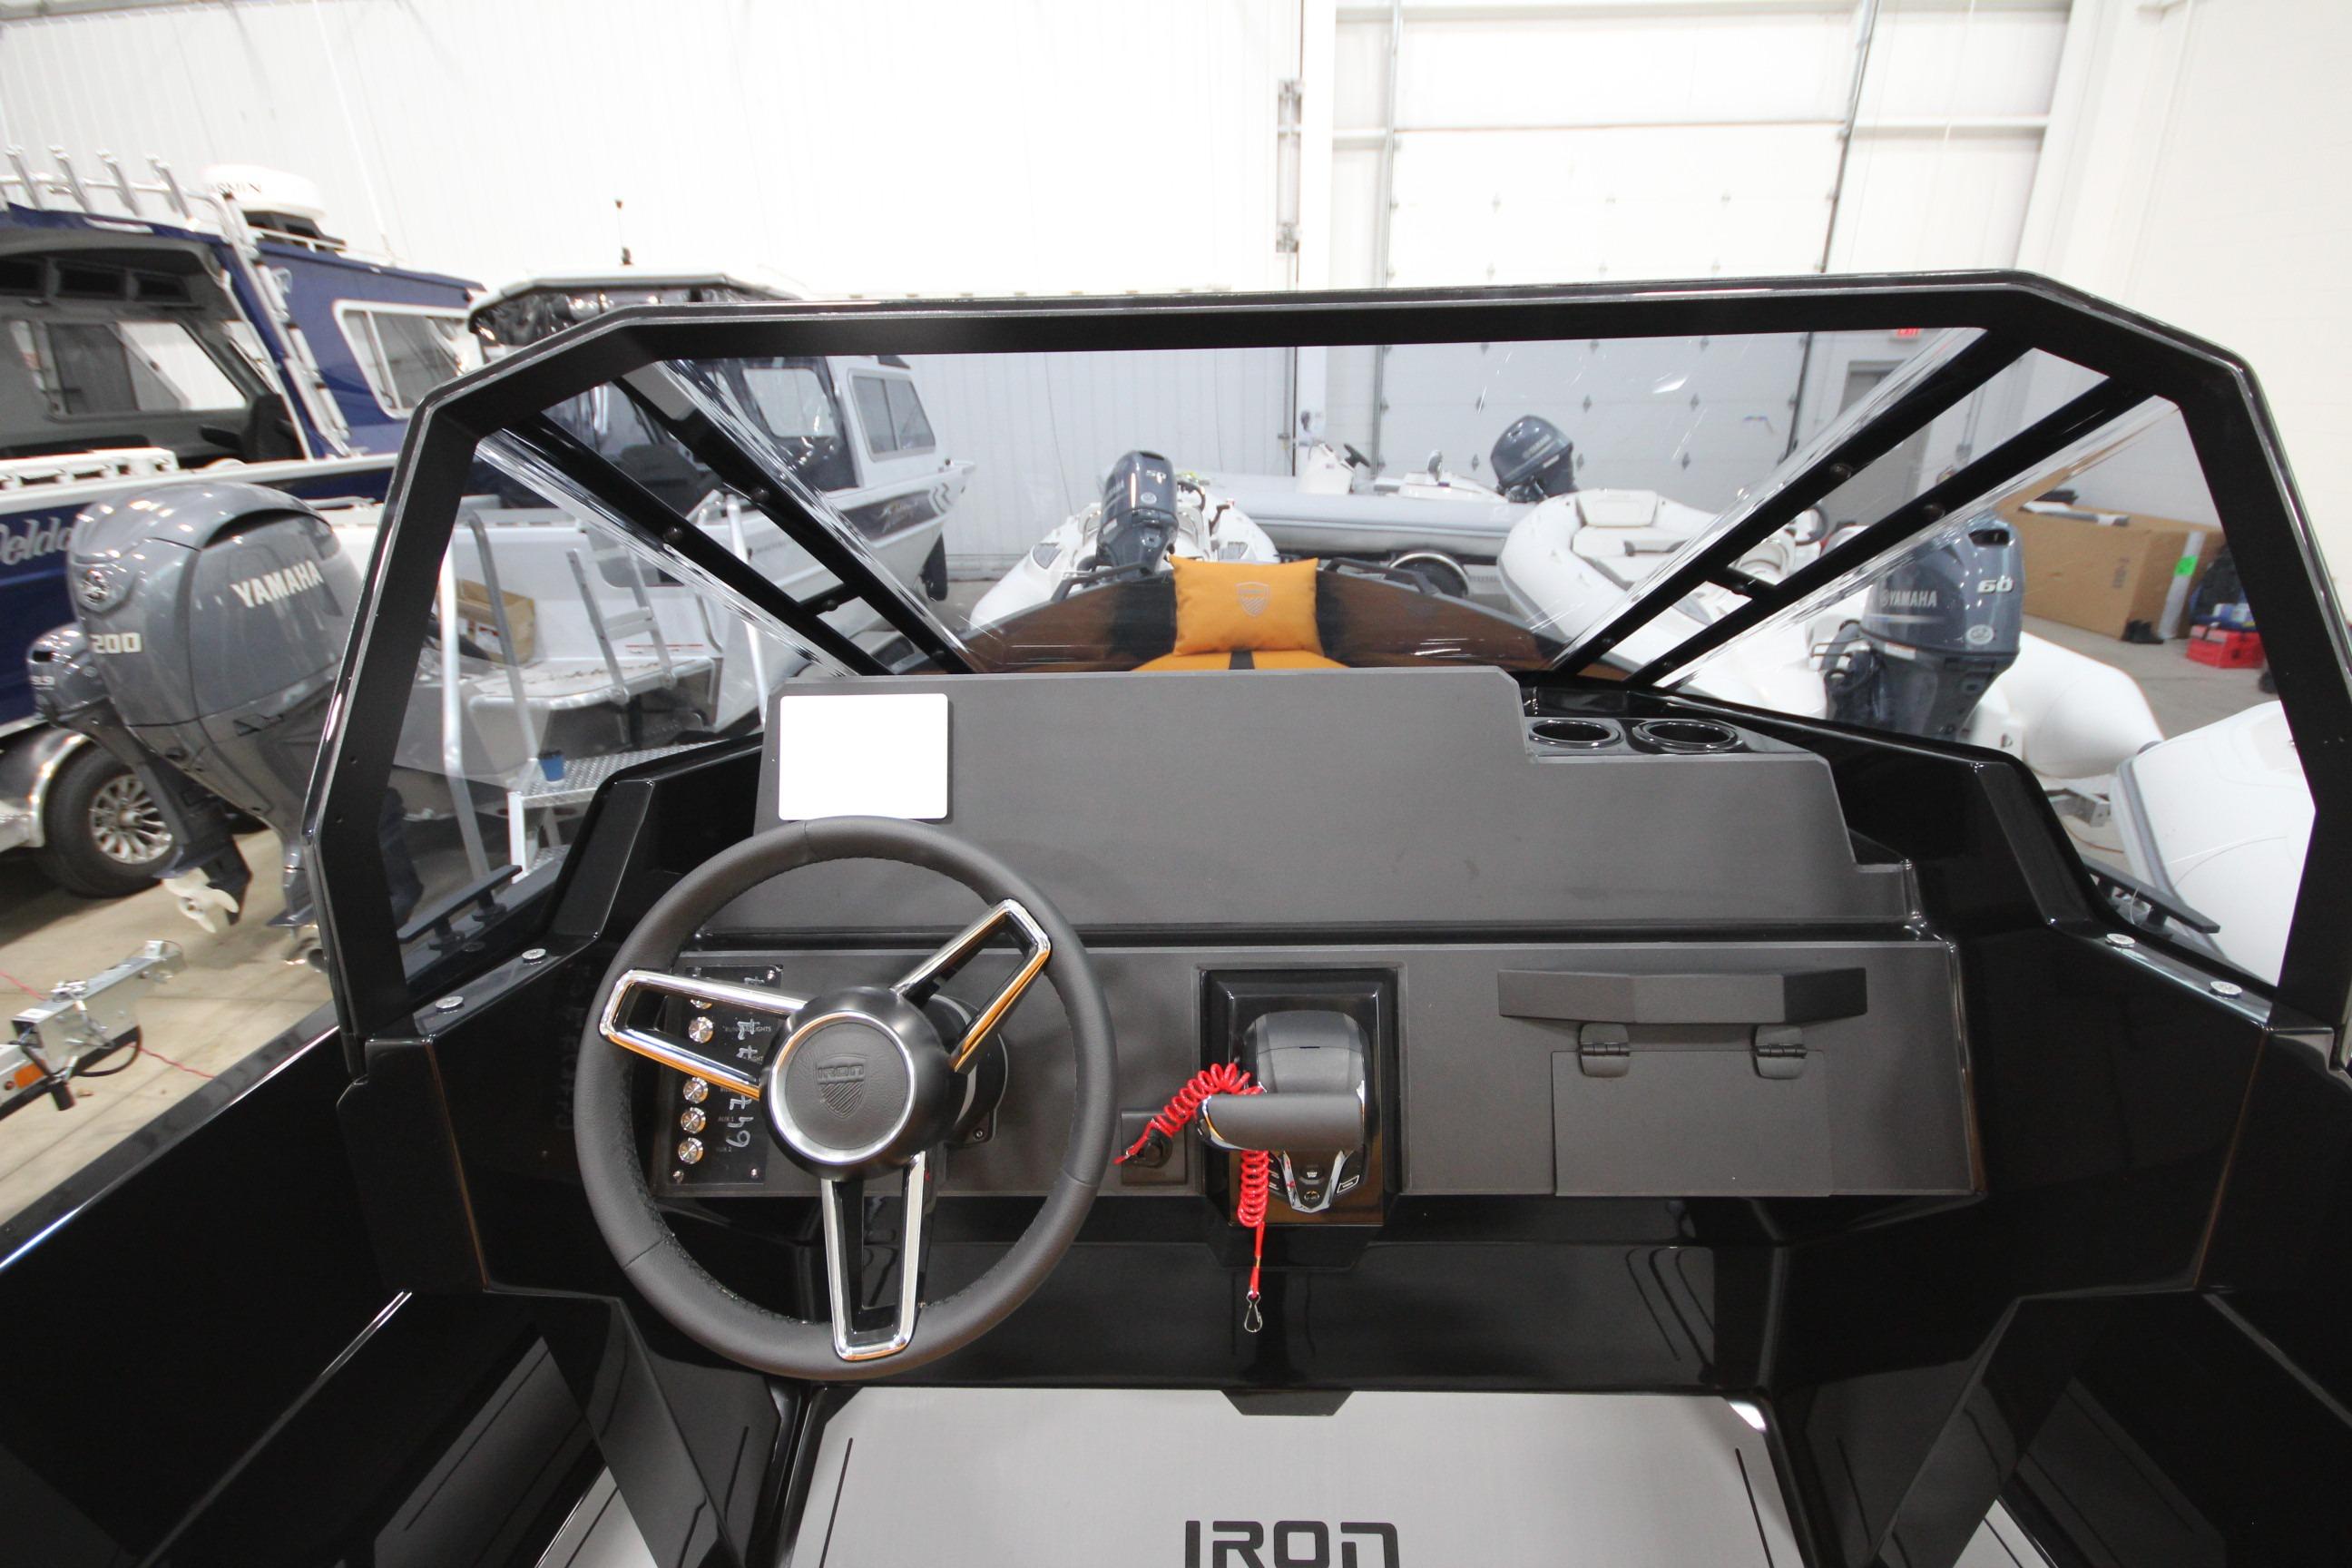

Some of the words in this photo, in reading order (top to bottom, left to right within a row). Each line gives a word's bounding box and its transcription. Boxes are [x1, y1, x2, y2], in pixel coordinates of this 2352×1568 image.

[229, 559, 325, 609] YAMAHA
[1888, 590, 1938, 609] YAMAHA
[89, 632, 142, 654] 200
[1184, 1520, 1400, 1568] IRON
